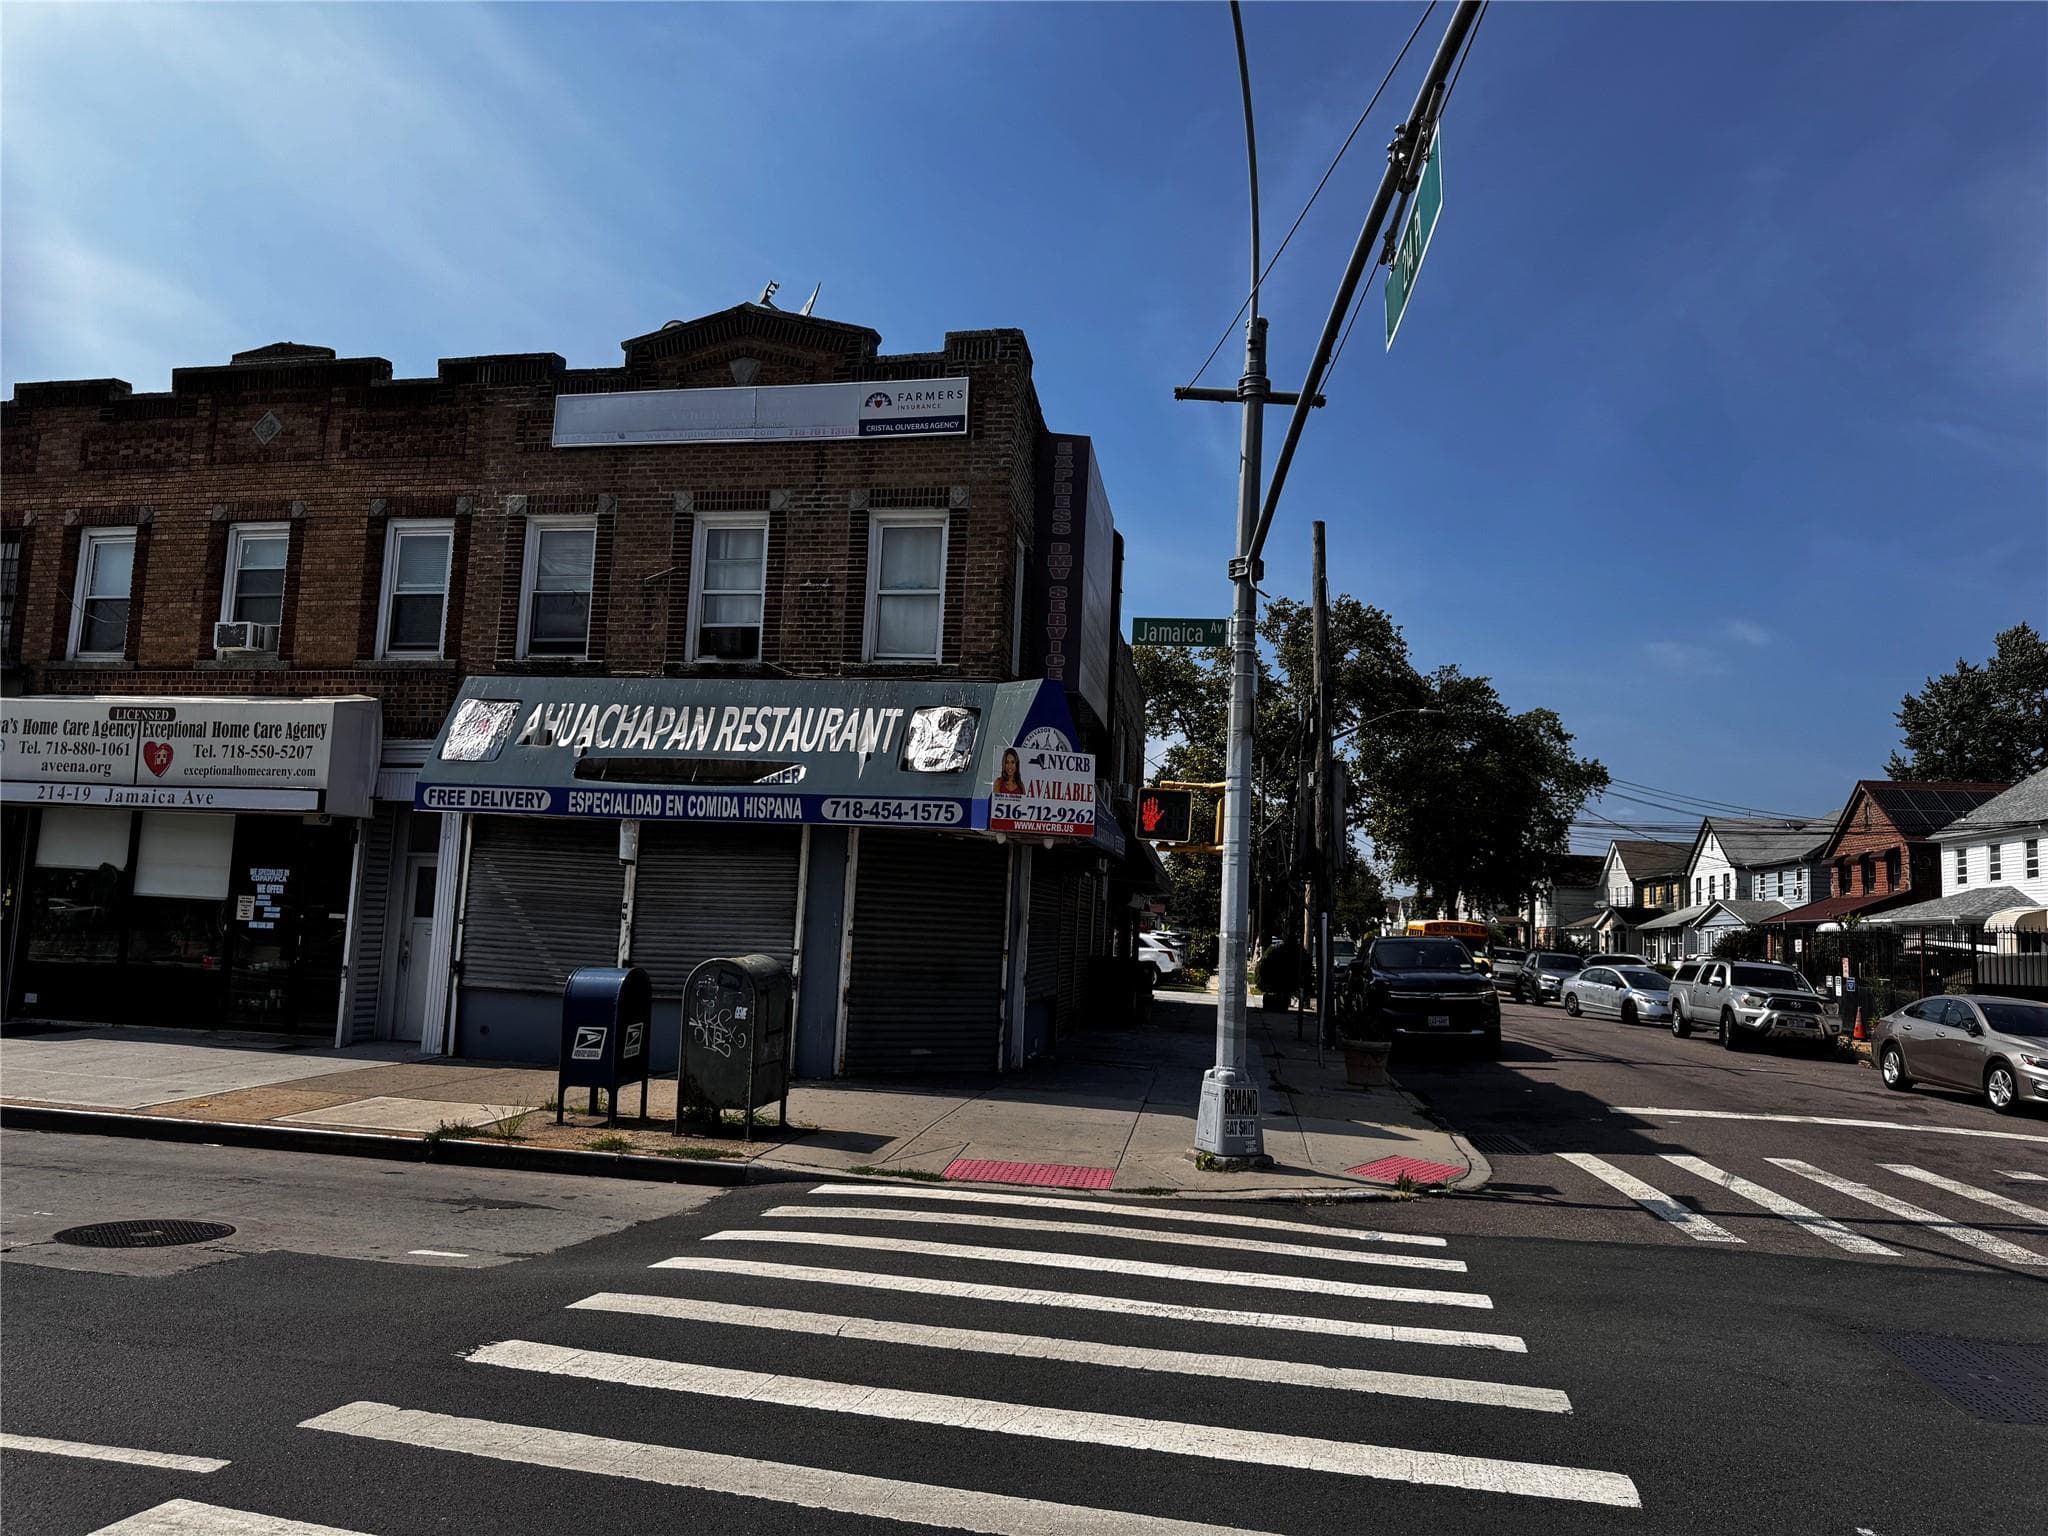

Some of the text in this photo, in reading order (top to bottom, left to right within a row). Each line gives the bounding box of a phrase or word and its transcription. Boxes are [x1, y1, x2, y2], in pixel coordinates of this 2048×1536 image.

[1402, 229, 1414, 292] 214
[898, 390, 964, 402] FARMERS
[897, 403, 942, 411] INSURANCE
[866, 421, 960, 432] CRISTAL OLIVERAS AGENCY
[1051, 441, 1075, 536] EXPRESS
[1047, 542, 1073, 581] DMV
[1045, 585, 1069, 681] SERVICE
[1137, 621, 1224, 643] Jamaica Av
[115, 709, 169, 721] LICENSED
[23, 719, 58, 736] Home
[63, 720, 90, 737] Care
[92, 720, 137, 739] Agency
[143, 721, 327, 741] Exceptional Home Care Agency
[515, 703, 904, 753] AHUACHAPAN RESTAURANT
[19, 740, 130, 756] Tel. 718-880-1061
[193, 744, 313, 760] Tel. 718-550-5207
[41, 761, 112, 777] aveena.org
[183, 764, 316, 779] exceptionalhomecareny.com
[1048, 754, 1091, 772] NYCRB
[37, 785, 214, 805] 214-19 Jamaica Ave
[428, 789, 546, 809] FREE DELIVERY
[1027, 779, 1094, 802] AVAILABLE
[568, 791, 803, 820] ESPECIALIDAD EN COMIDA HISPANA
[830, 800, 955, 822] 718-454-1575
[994, 804, 1094, 824] 516-712-9262
[1014, 821, 1074, 833] WWW.NYCRB.US
[1225, 1089, 1258, 1116] REMAND
[1226, 1121, 1238, 1135] EAT
